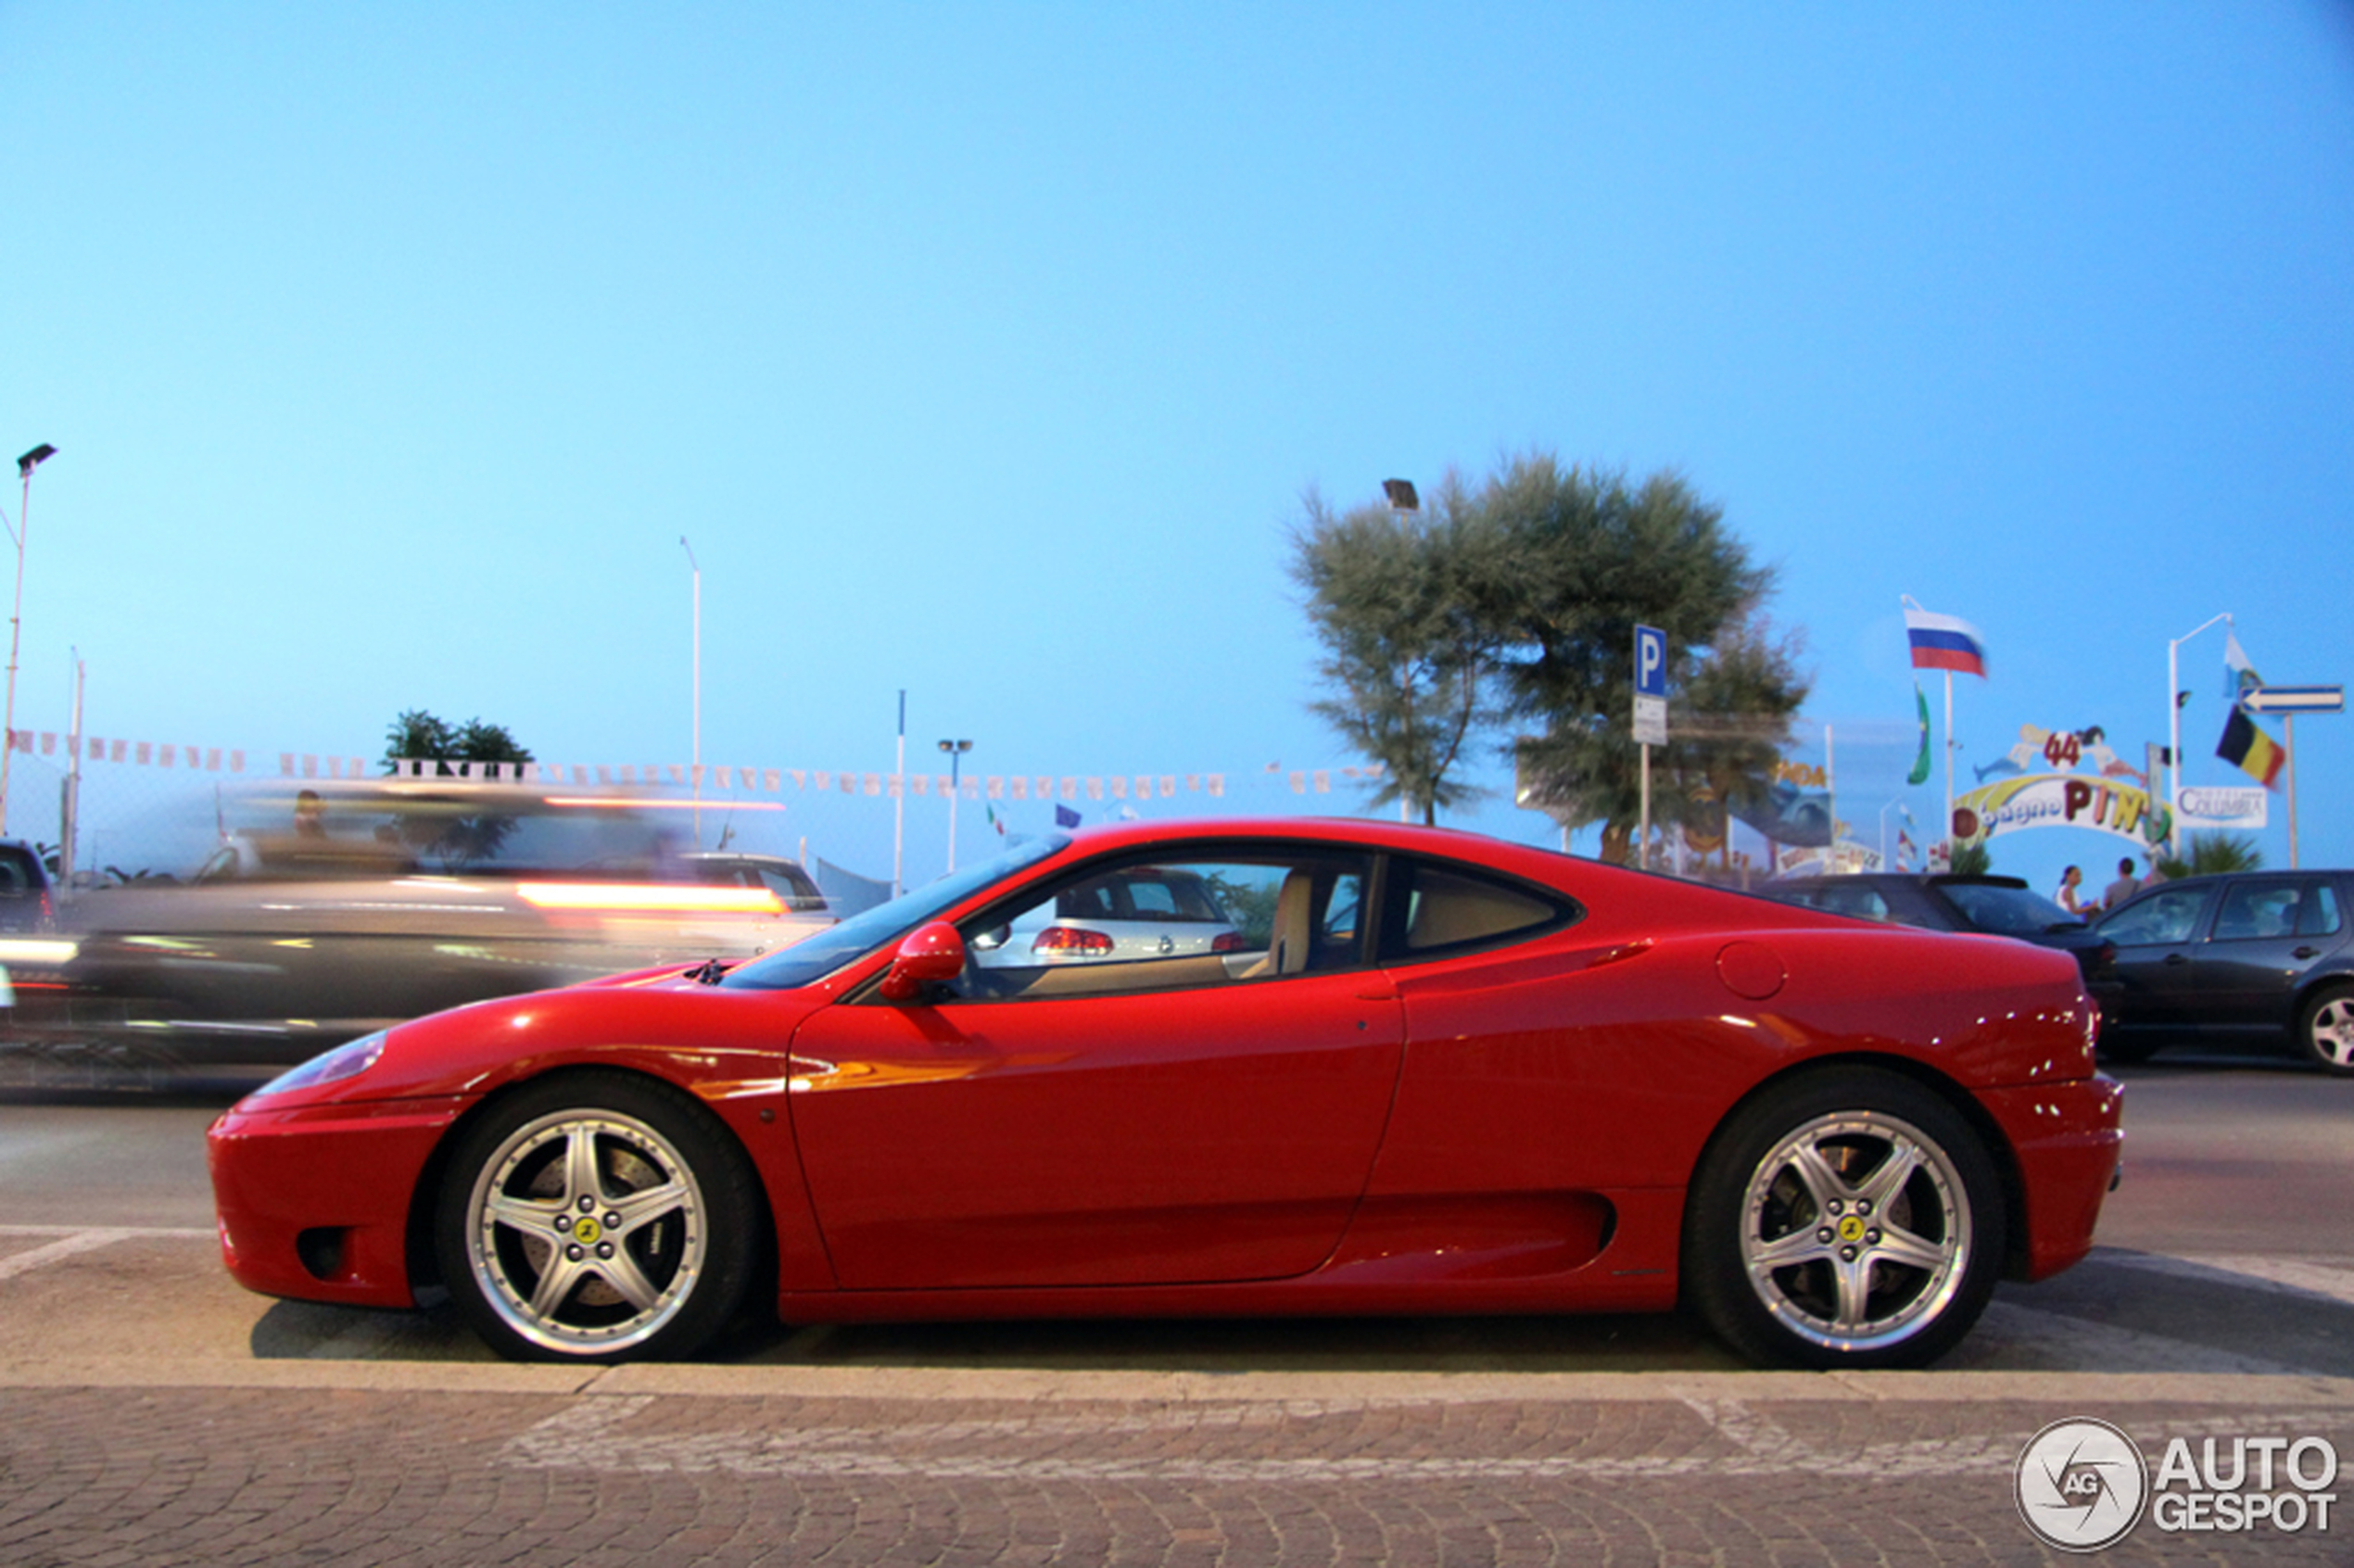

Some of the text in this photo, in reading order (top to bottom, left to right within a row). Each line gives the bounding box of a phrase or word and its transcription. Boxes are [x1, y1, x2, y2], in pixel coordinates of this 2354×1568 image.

[1641, 634, 1660, 688] P
[2044, 732, 2081, 767] 44
[1981, 798, 2061, 827] bagno
